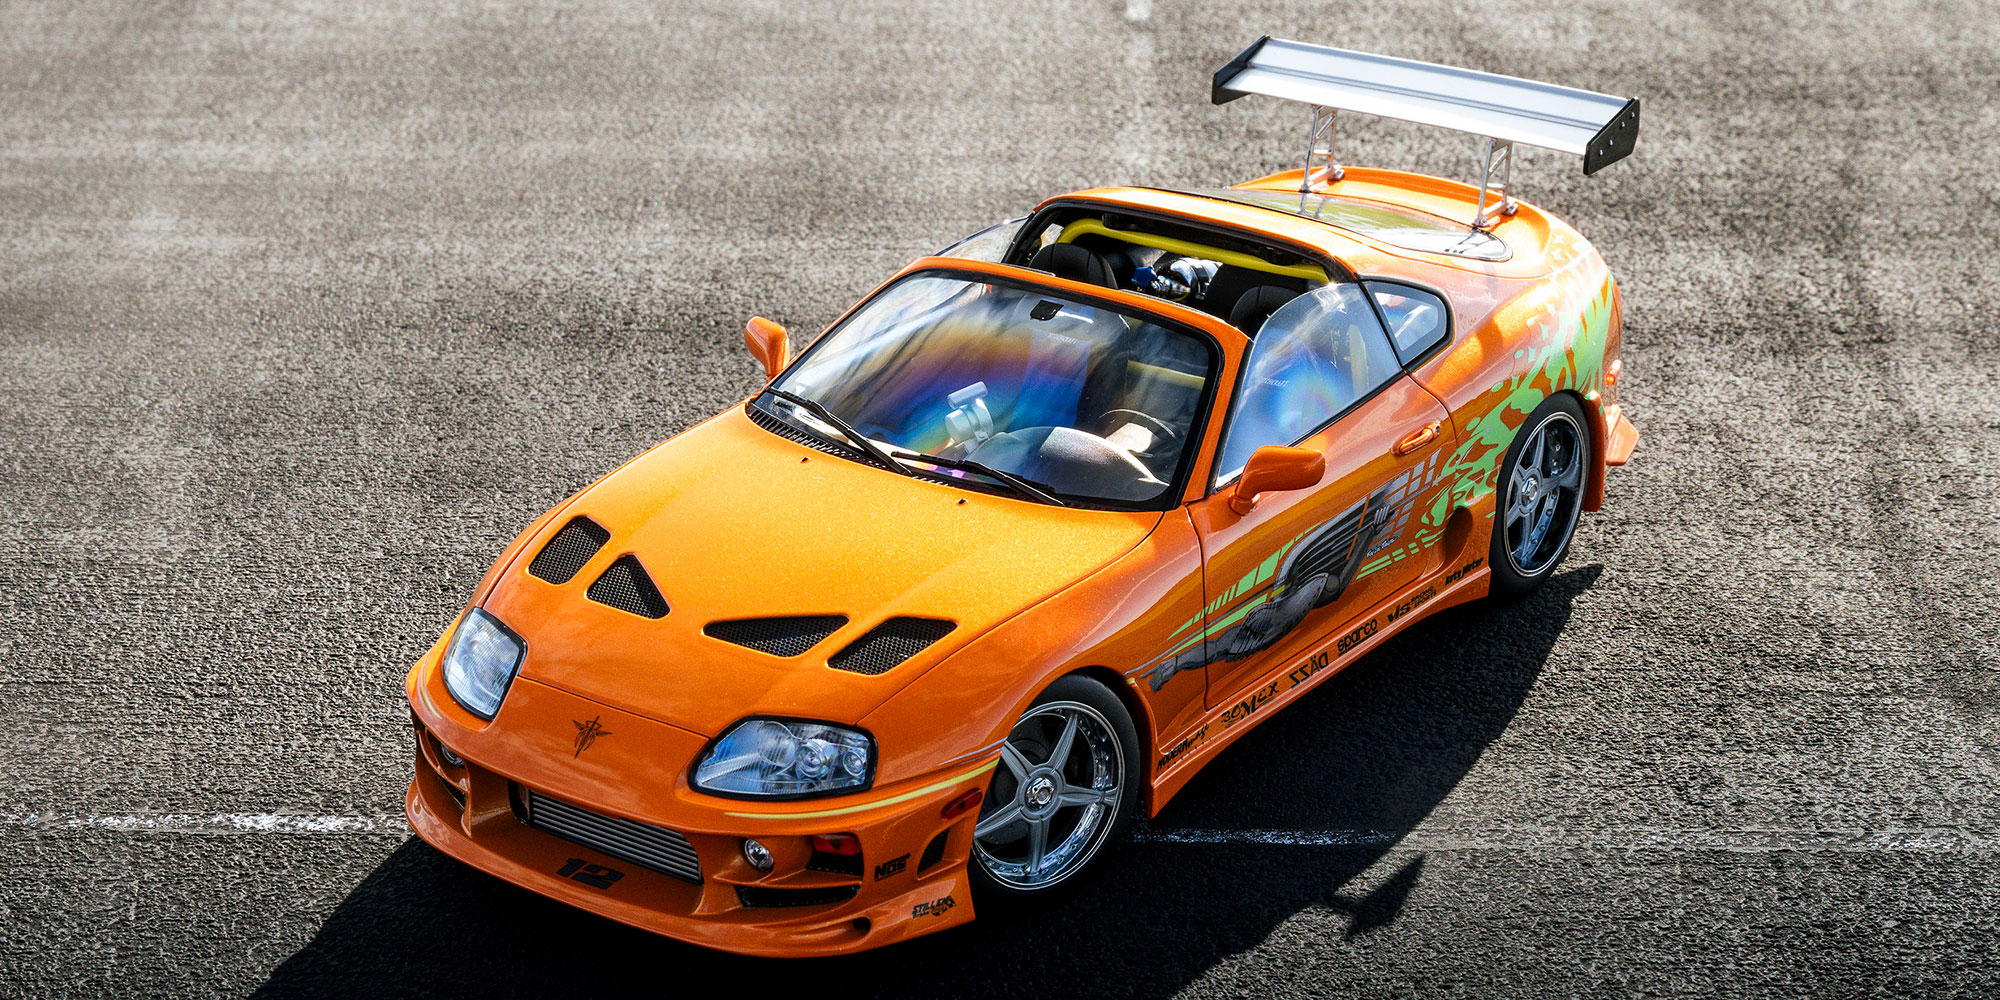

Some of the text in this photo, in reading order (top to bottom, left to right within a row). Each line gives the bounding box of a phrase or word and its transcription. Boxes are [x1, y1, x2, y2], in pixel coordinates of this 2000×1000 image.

[1337, 618, 1378, 655] sparco
[556, 858, 625, 890] 12
[874, 854, 910, 882] NOS
